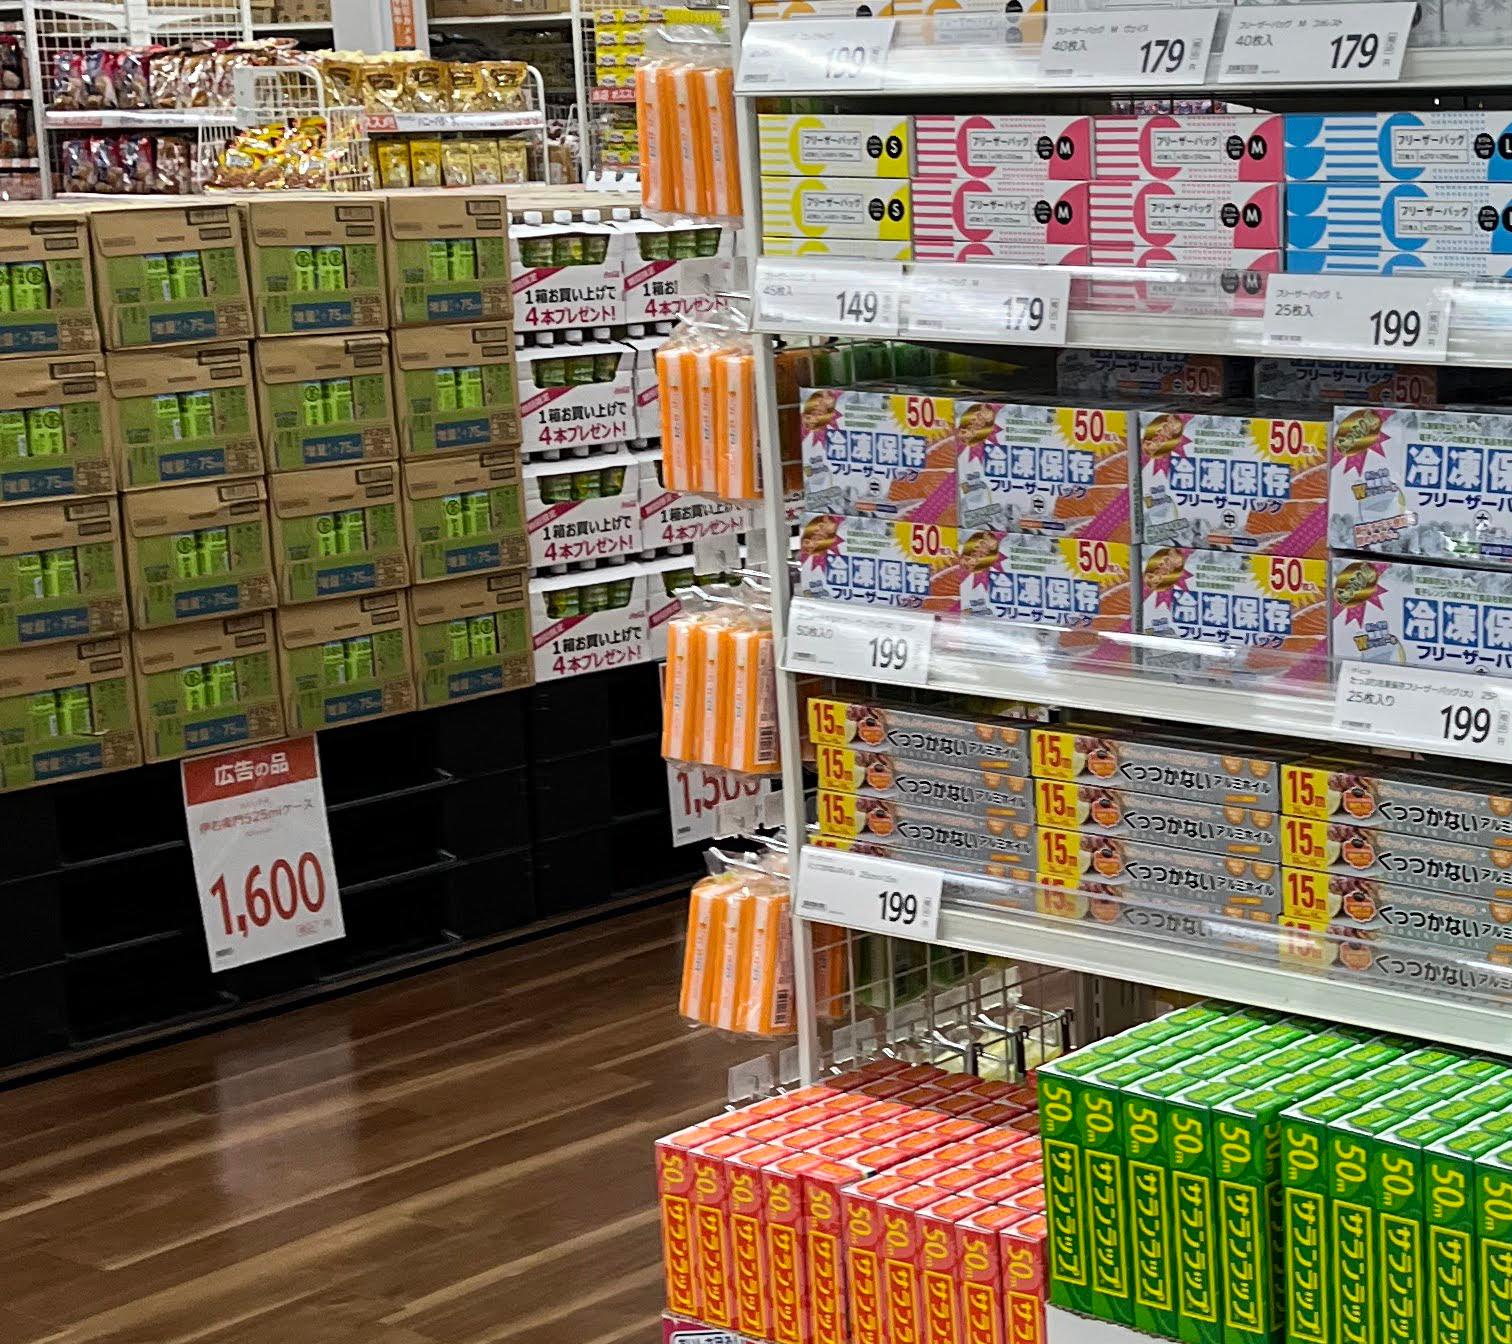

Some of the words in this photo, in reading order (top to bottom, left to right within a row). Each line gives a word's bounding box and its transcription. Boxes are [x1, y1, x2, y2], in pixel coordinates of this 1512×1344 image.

[1140, 38, 1185, 74] 179
[1330, 32, 1379, 69] 179
[889, 141, 898, 154] S
[1060, 141, 1073, 154] M
[1250, 141, 1264, 155] M
[1505, 139, 1512, 153] L
[891, 203, 901, 216] S
[1057, 205, 1070, 218] M
[1246, 209, 1259, 222] M
[525, 285, 617, 305] 1箱お買い上げて
[836, 291, 878, 323] 149
[1275, 304, 1314, 317] 25枚入
[525, 306, 617, 326] 4本プレゼント!
[1370, 309, 1421, 347] 199
[538, 401, 628, 424] 1箱お買い上げて
[538, 421, 627, 445] 4本プレゼント!
[826, 430, 926, 469] 冷凍保存
[984, 443, 1094, 484] 冷凍保存
[1171, 456, 1291, 498] 冷凍保存
[543, 515, 632, 541] 1箱お買い上げて
[544, 534, 633, 561] 4本プレゼント!
[826, 556, 931, 595] 冷凍保存
[988, 572, 1100, 614] 冷凍保存
[1173, 591, 1293, 635] 冷凍保存
[869, 636, 909, 670] 199
[1440, 705, 1491, 743] 199
[214, 751, 290, 787] 広告の品
[209, 851, 326, 938] 1,600
[878, 890, 917, 926] 199
[1050, 1149, 1082, 1281] サランラップ
[1092, 1158, 1123, 1292] サランラップ
[1136, 1171, 1167, 1304] サランラップ
[1180, 1182, 1212, 1317] サランラップ
[1226, 1192, 1259, 1329] サランラップ
[1292, 1198, 1322, 1339] サランラップ
